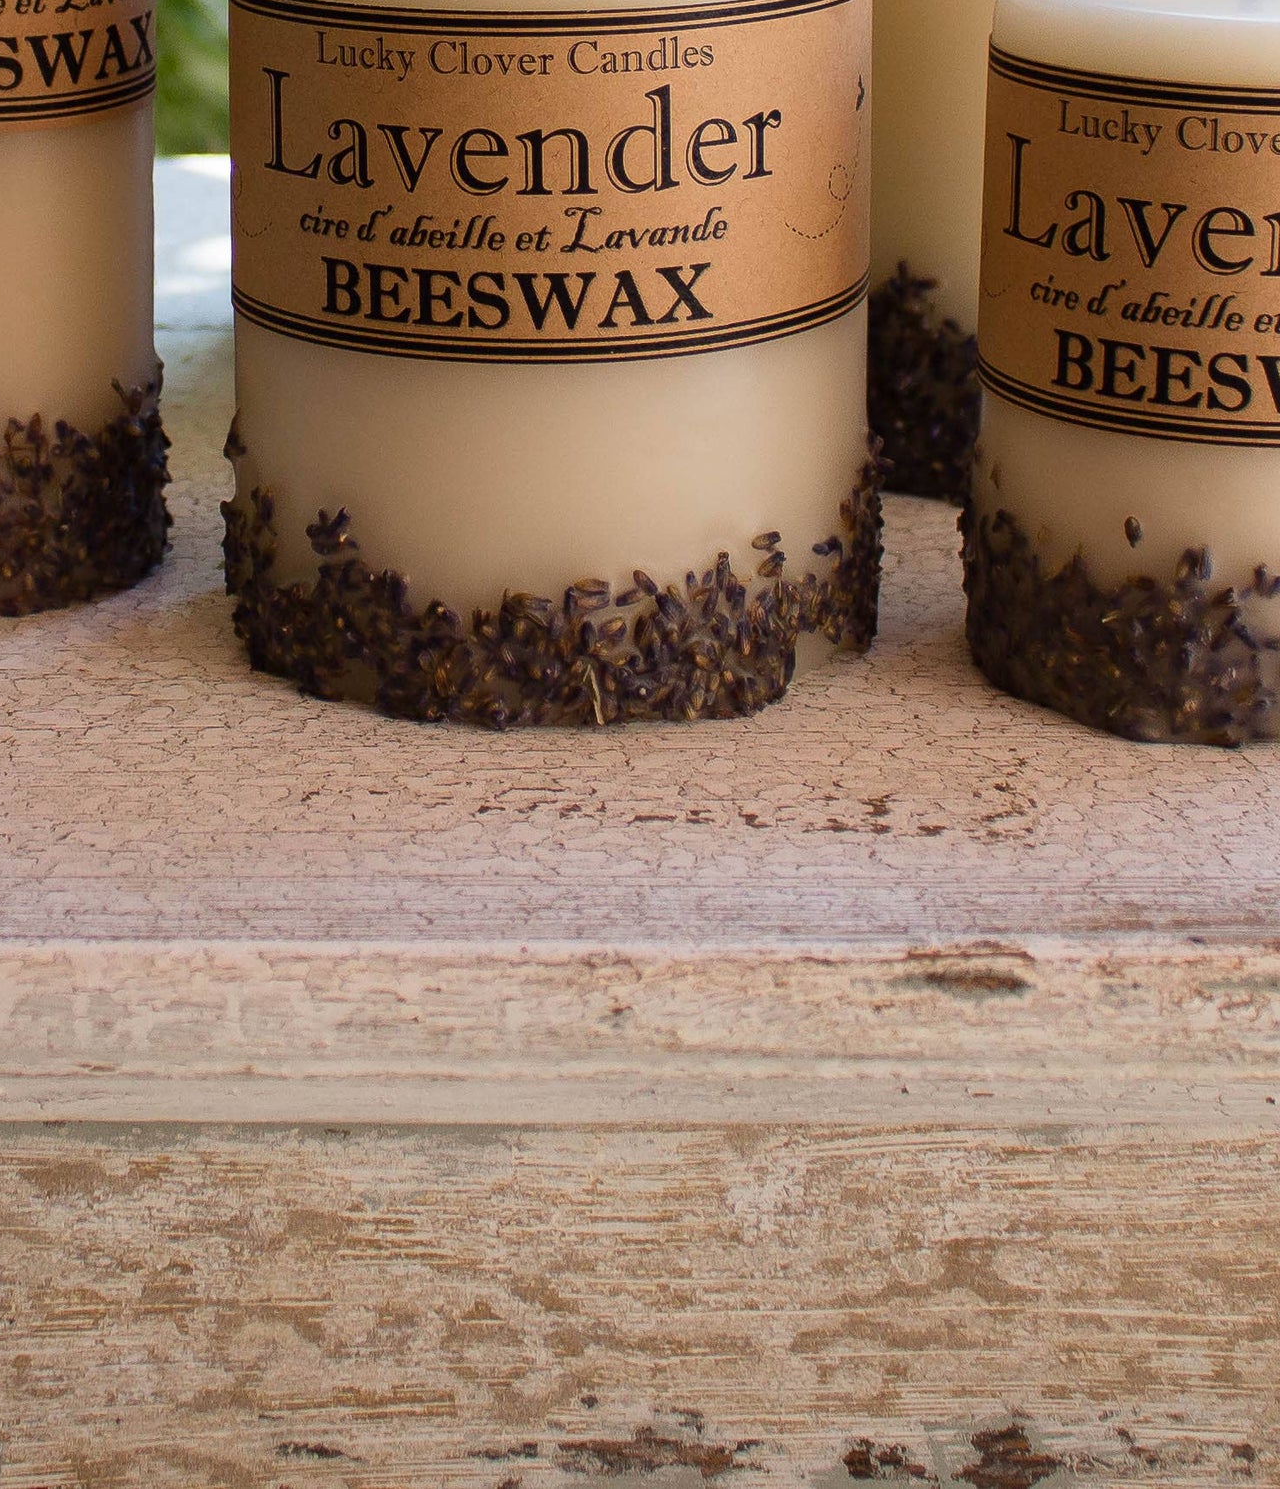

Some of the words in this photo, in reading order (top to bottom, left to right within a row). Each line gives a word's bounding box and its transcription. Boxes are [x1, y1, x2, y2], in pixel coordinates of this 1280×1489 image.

[315, 31, 416, 82] Lucky
[427, 39, 554, 77] Clover
[566, 36, 715, 76] Candles
[262, 66, 782, 197] Lavender
[1057, 98, 1163, 155] Lucky
[299, 204, 350, 243] cire
[514, 225, 552, 255] et
[559, 204, 729, 256] Lavande
[320, 255, 715, 332] BEESWAX
[1029, 274, 1080, 311] cire
